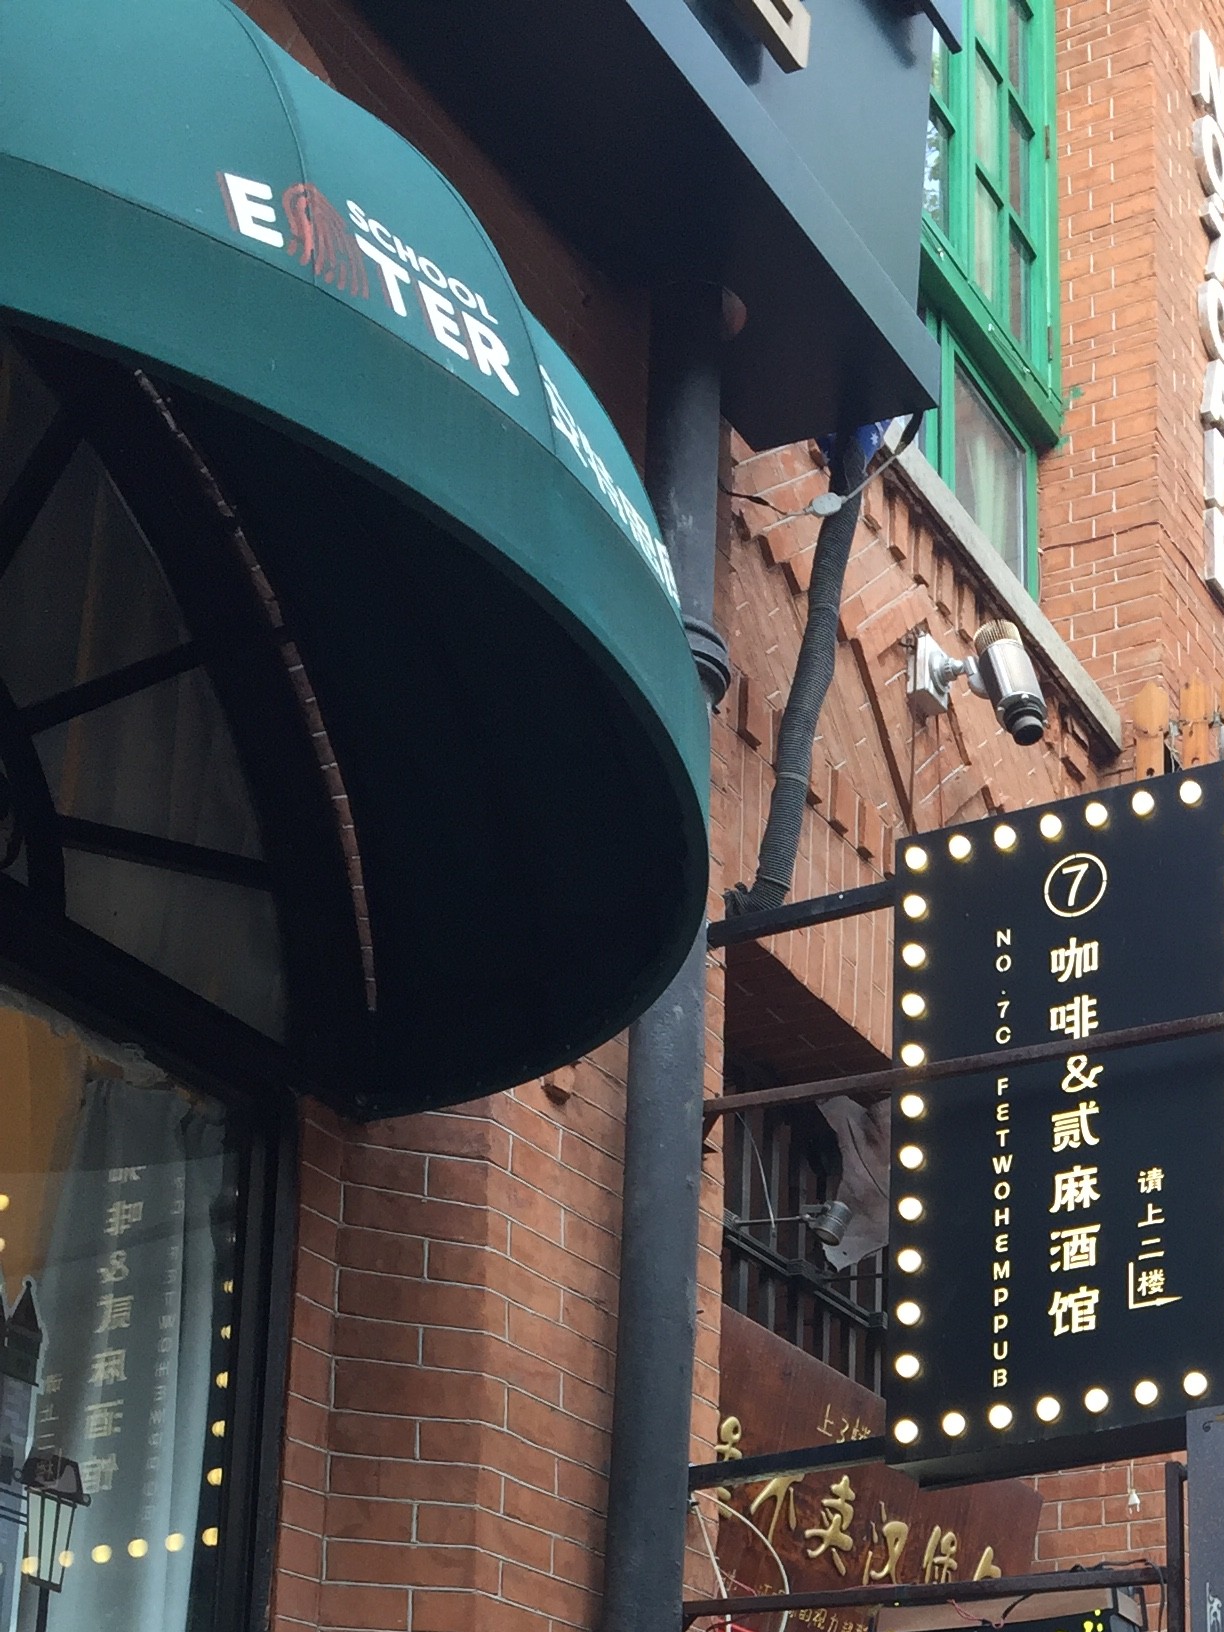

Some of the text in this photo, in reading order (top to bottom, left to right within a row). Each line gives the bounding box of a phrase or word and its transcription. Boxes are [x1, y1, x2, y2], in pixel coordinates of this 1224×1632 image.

[345, 200, 498, 325] SCHOOL
[1137, 1167, 1165, 1297] 请上二楼
